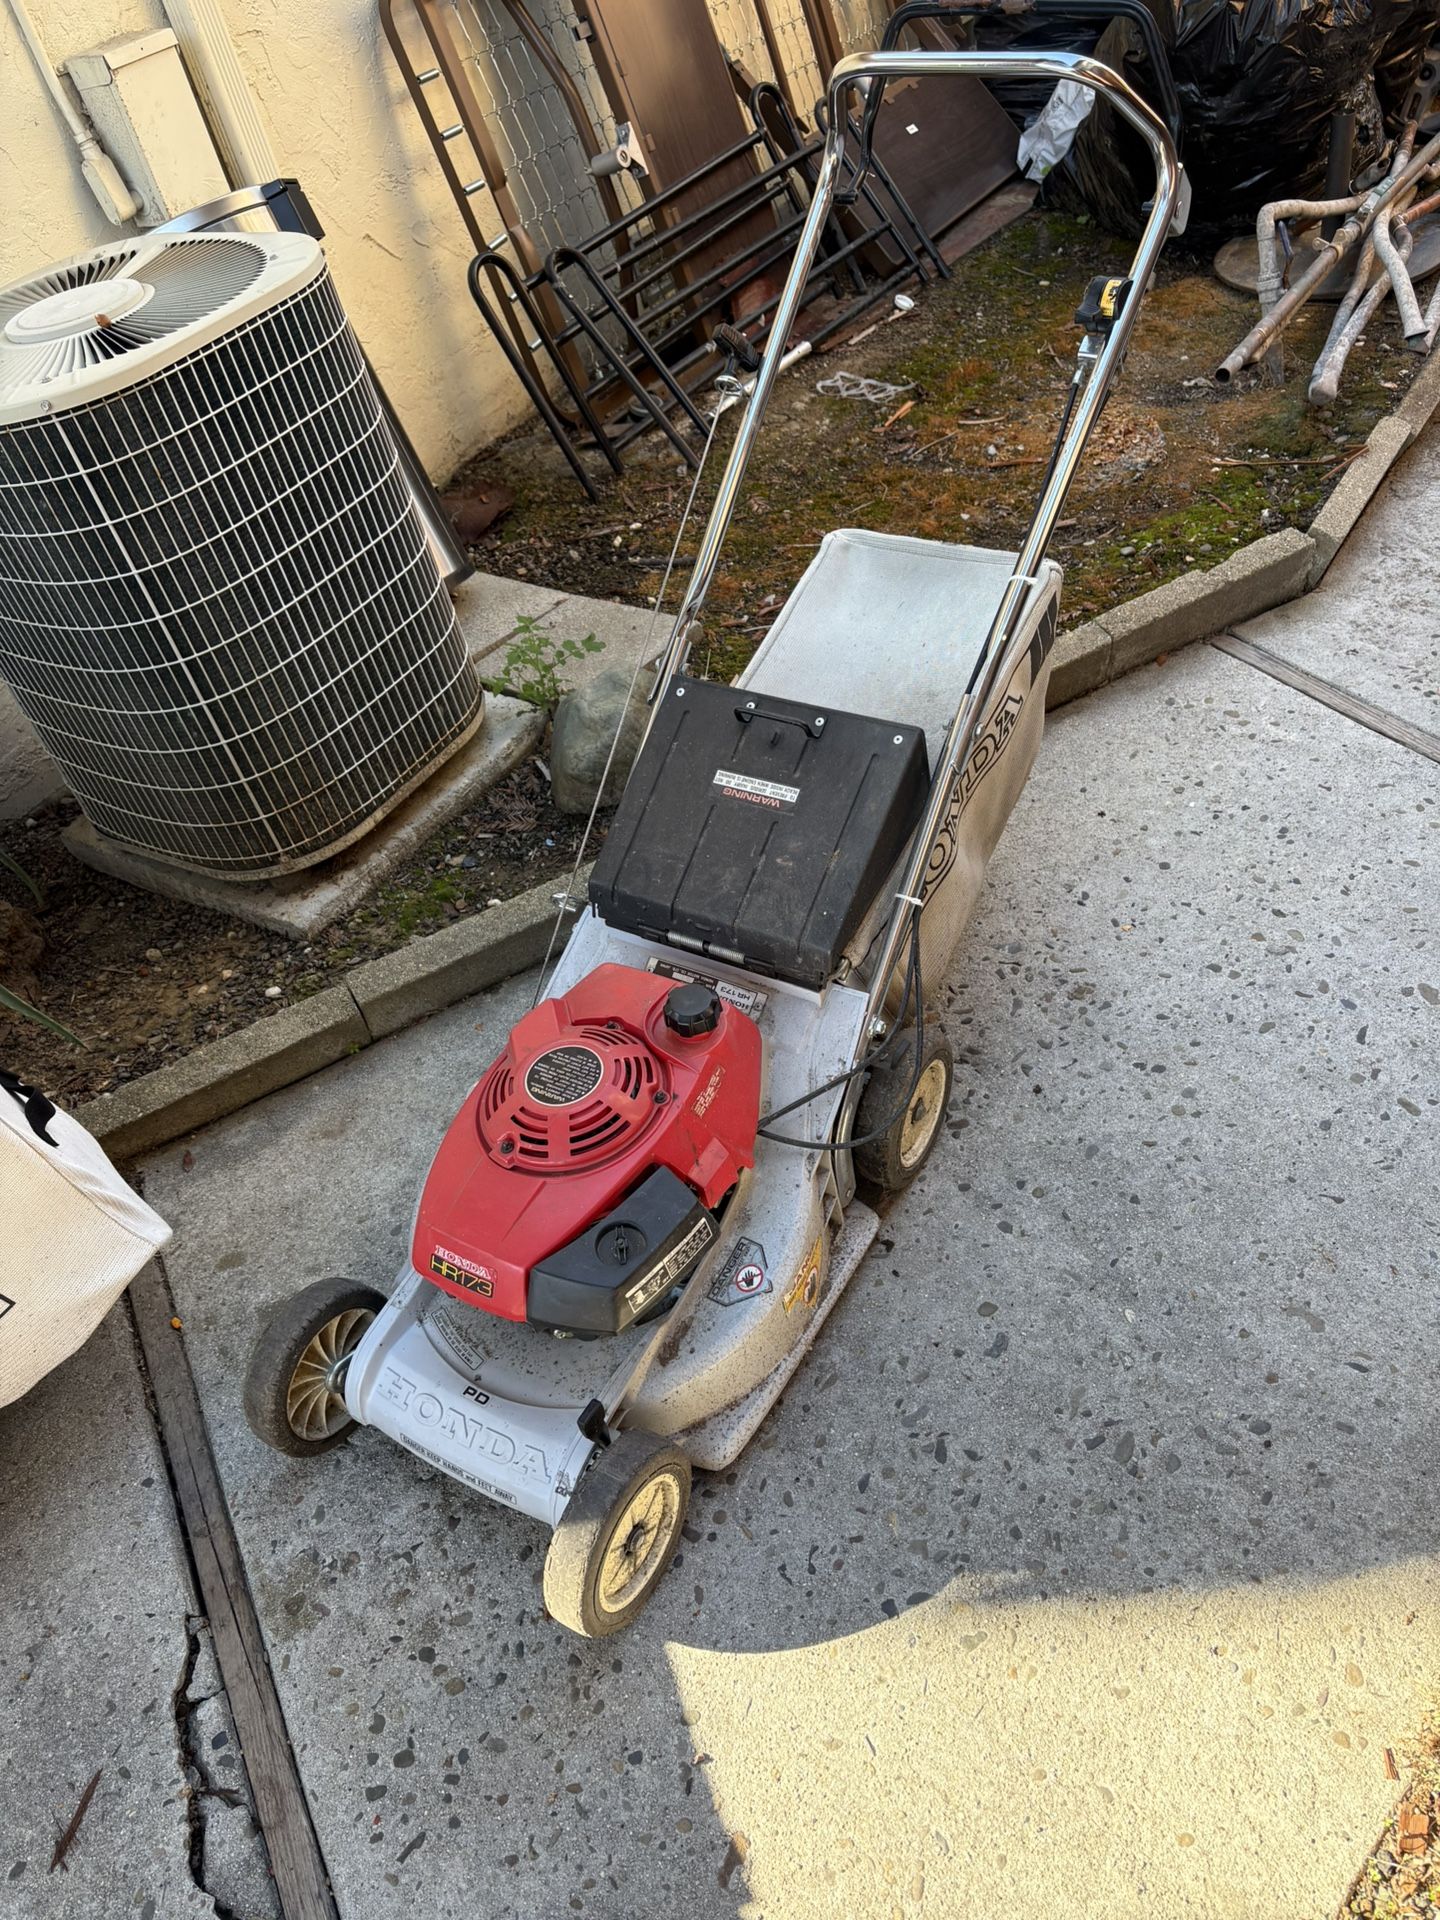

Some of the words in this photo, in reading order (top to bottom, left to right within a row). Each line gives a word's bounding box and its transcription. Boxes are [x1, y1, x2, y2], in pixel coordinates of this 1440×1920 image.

[722, 786, 780, 807] WARNING
[922, 694, 1023, 900] ONDA
[431, 1254, 493, 1297] HR173
[435, 1244, 491, 1281] HONDA
[711, 1241, 746, 1296] DANGER
[463, 1386, 490, 1405] PD
[378, 1366, 552, 1485] HONDA
